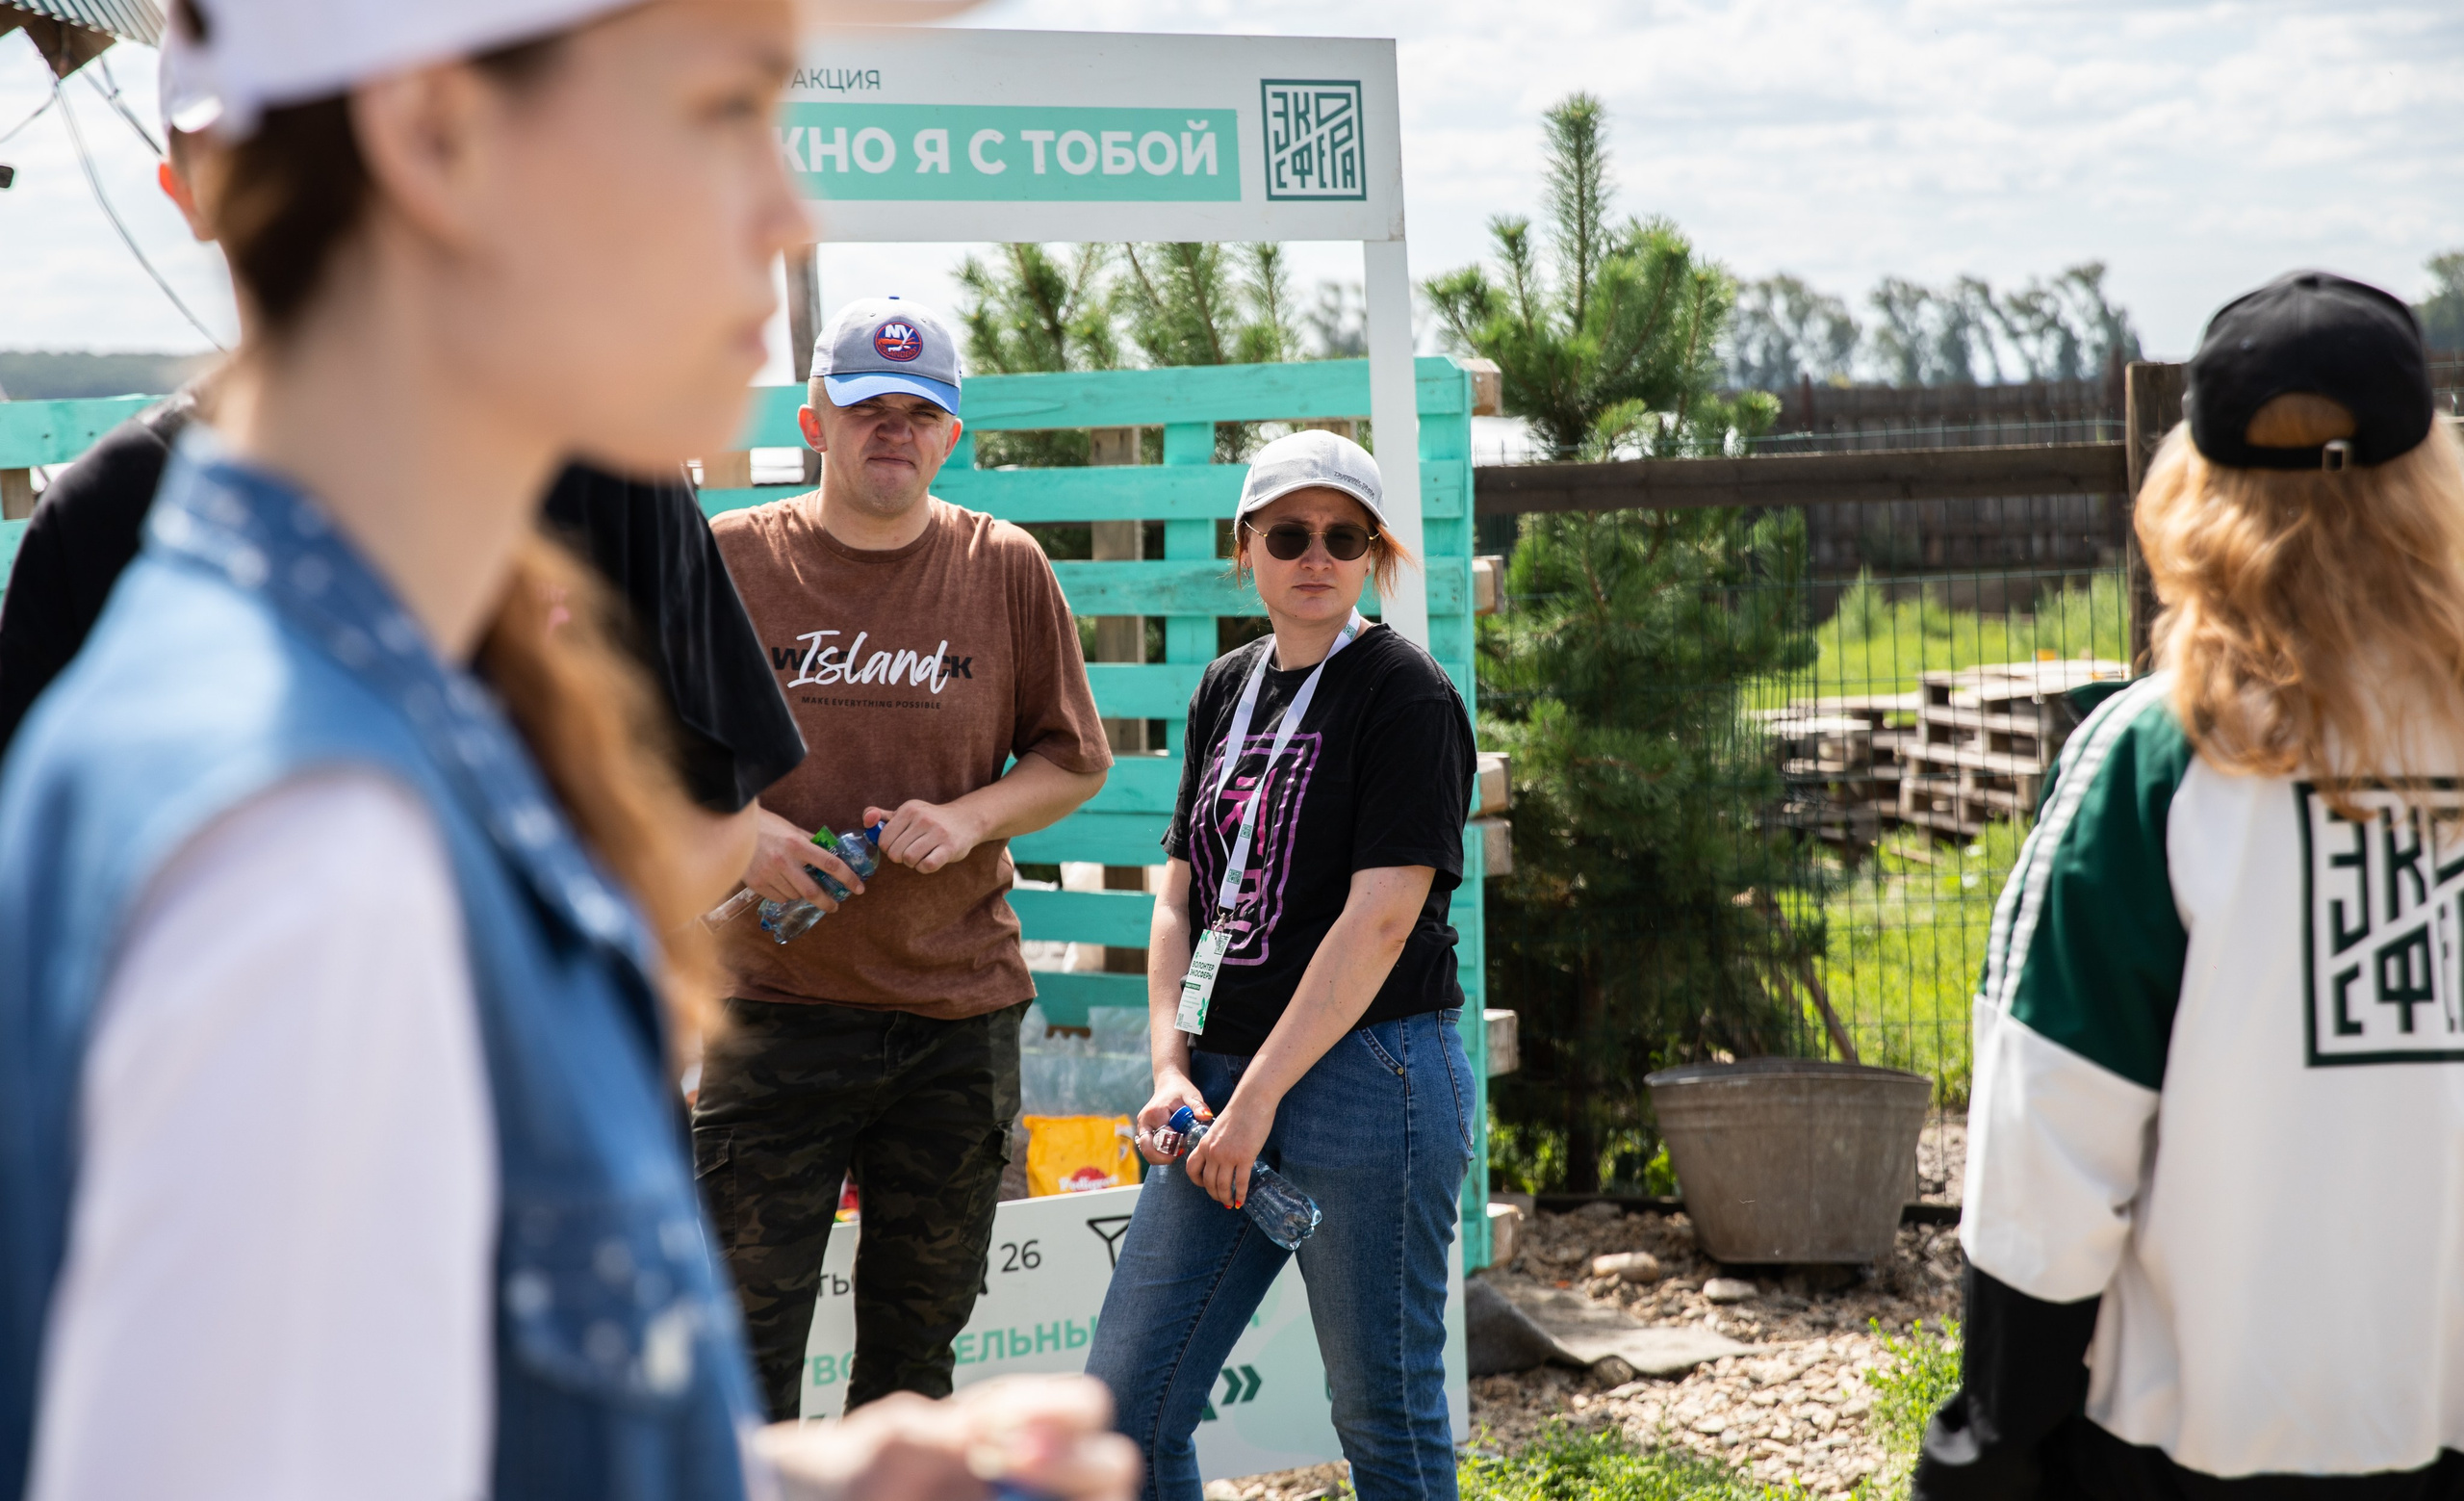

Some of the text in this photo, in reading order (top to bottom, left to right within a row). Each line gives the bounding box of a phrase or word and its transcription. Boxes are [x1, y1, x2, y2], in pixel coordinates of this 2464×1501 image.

[790, 68, 881, 93] АКЦИЯ
[913, 129, 950, 174] Я
[968, 128, 1007, 174] С
[1020, 119, 1218, 175] ТОБОЙ
[786, 630, 948, 694] Island
[801, 696, 941, 710] MAKE EVERYTHING POSSIBLE
[1000, 1239, 1042, 1273] 26
